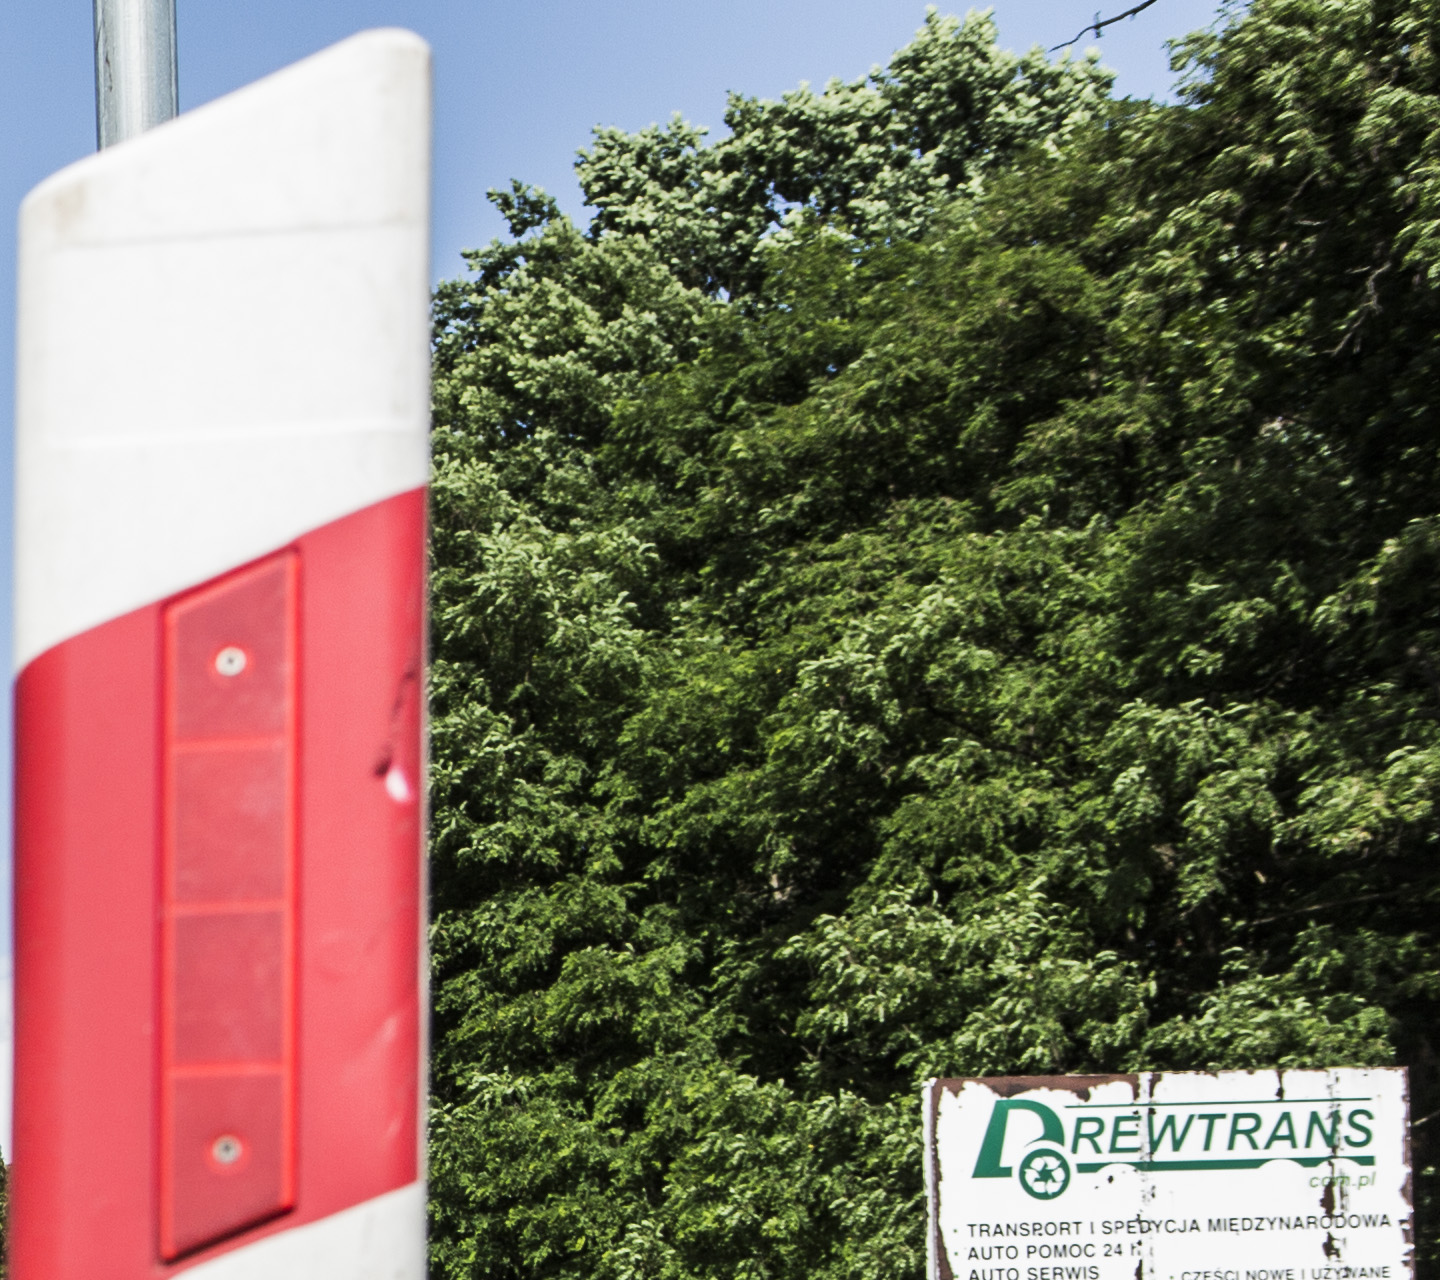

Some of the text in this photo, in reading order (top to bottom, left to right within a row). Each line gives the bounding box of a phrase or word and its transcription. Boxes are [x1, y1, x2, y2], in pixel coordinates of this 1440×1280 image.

[972, 1099, 1376, 1178] DREWTRANS
[967, 1213, 1392, 1238] TRANSPORT I SPEDYCJA MIĘDZYNARODOWA
[968, 1245, 1019, 1260] AUTO
[1026, 1244, 1096, 1259] POMOC
[1103, 1243, 1123, 1257] 24
[1246, 1268, 1295, 1280] NOWE
